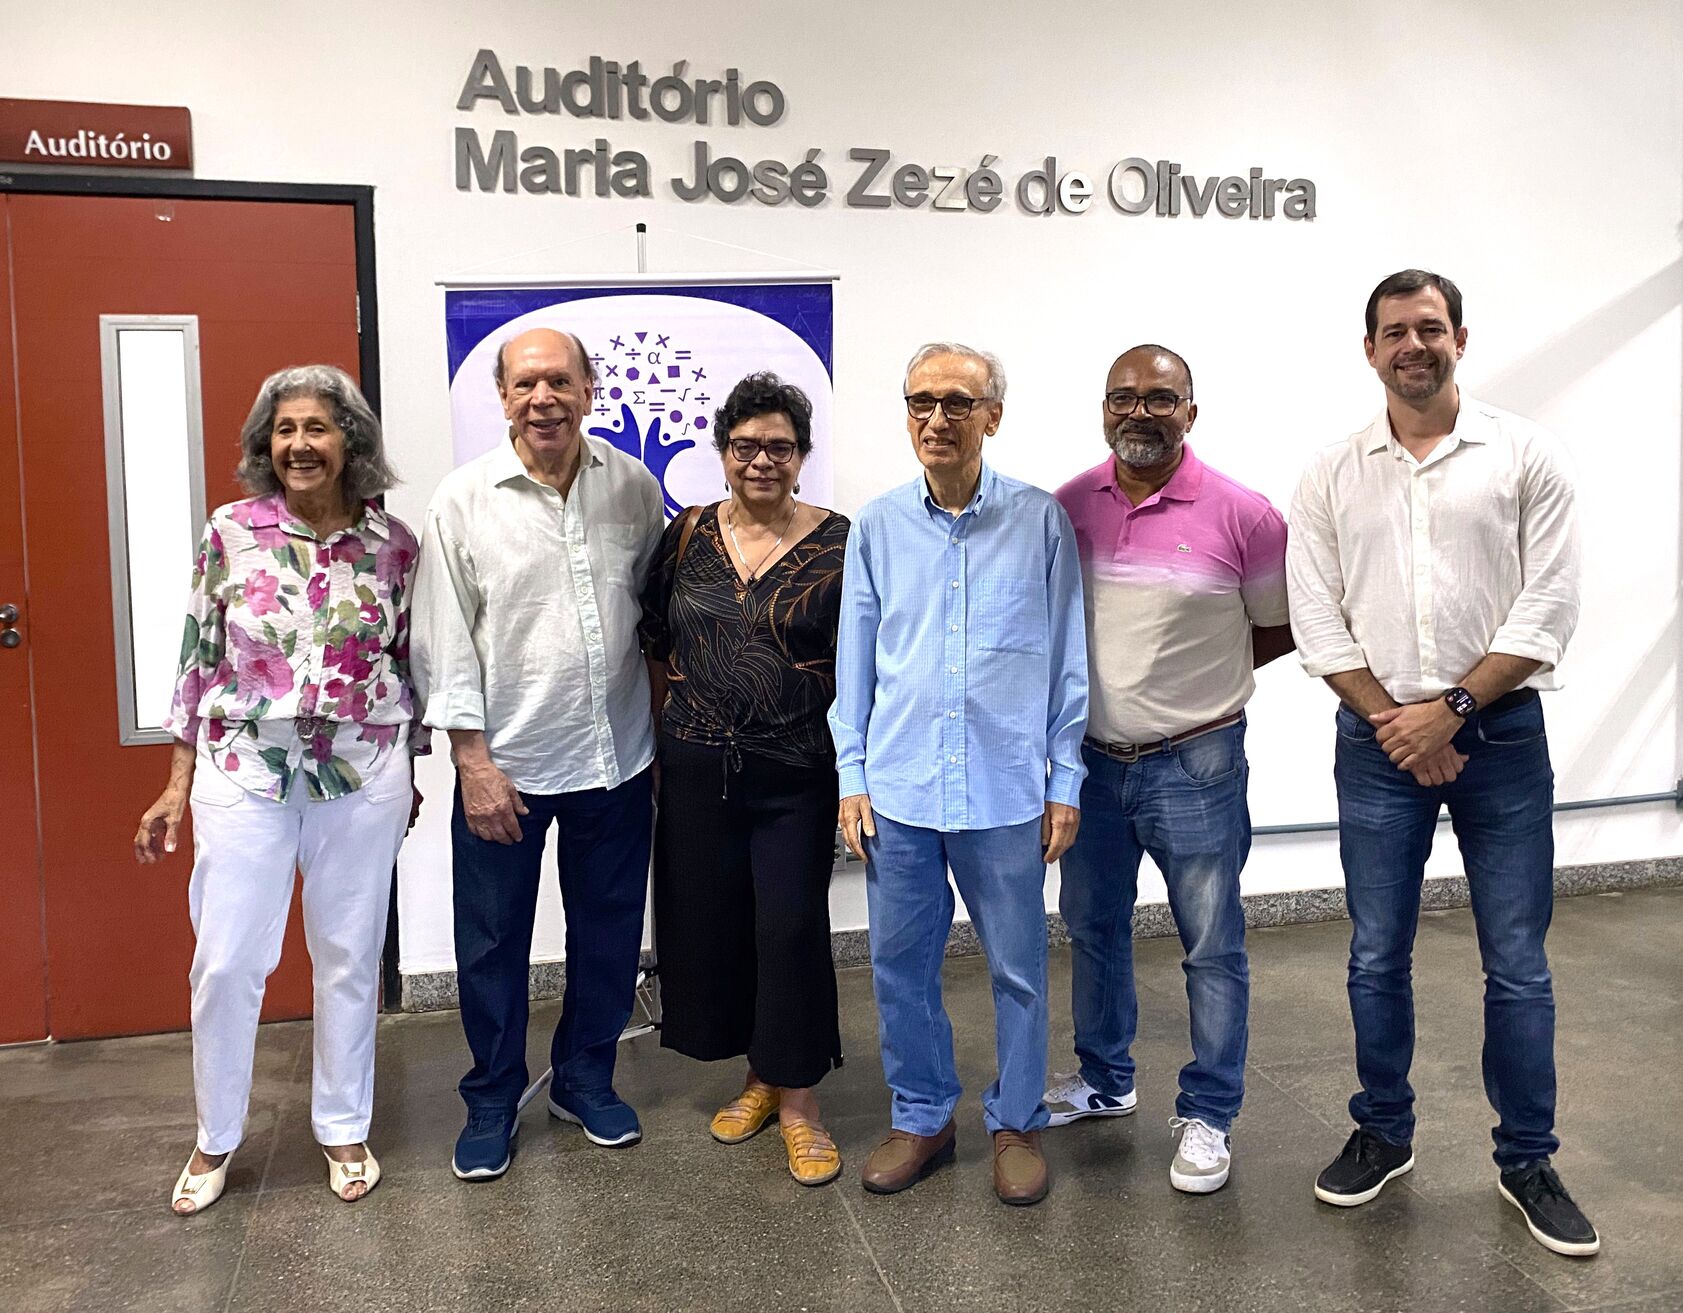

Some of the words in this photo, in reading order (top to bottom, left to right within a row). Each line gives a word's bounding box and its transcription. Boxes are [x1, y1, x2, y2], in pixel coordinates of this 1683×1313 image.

[456, 48, 786, 127] Auditório
[24, 129, 172, 161] Auditório
[455, 127, 651, 197] Maria
[671, 140, 828, 207] José
[846, 147, 1003, 212] Zezé
[1017, 156, 1094, 215] de
[1108, 157, 1317, 220] Oliveira
